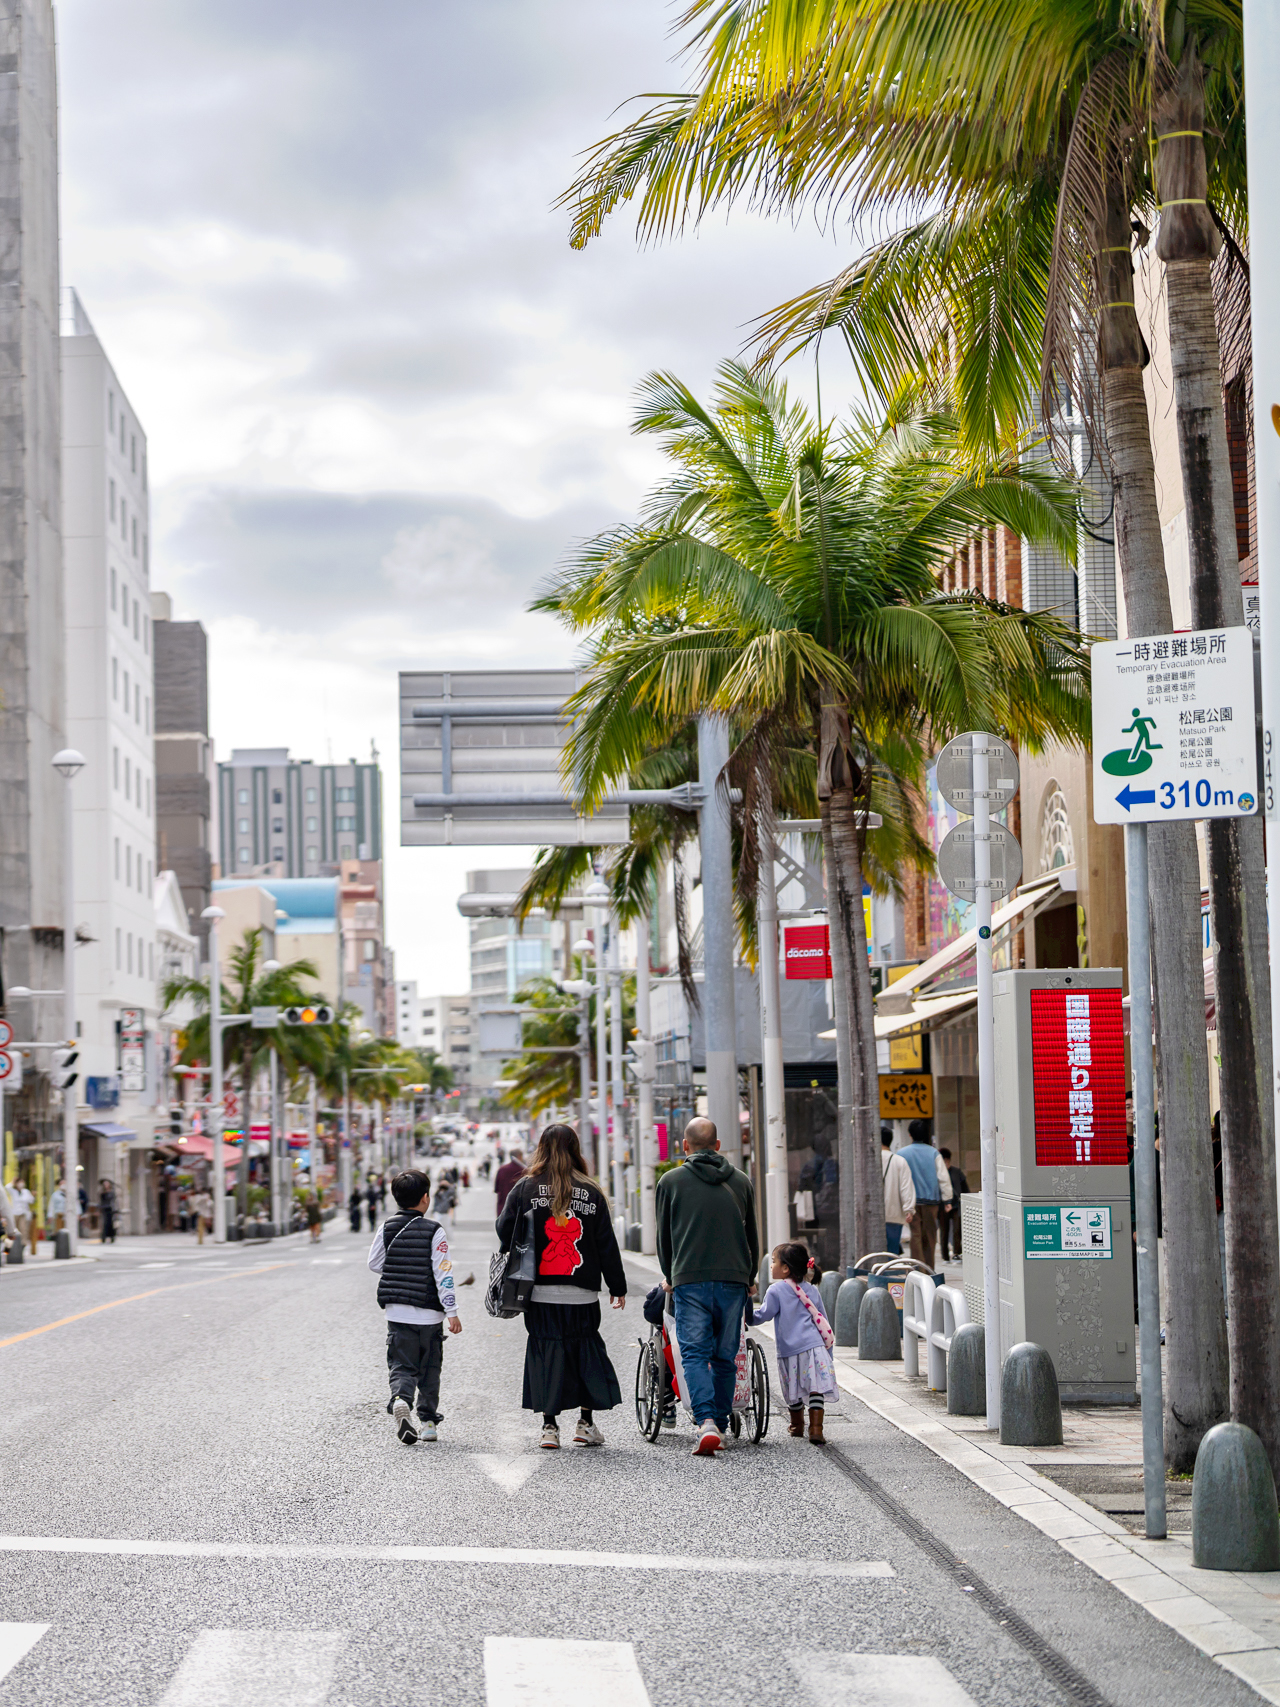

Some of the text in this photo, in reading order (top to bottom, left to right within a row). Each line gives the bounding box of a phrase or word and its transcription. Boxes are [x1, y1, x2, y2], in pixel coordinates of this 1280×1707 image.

[1116, 634, 1226, 661] 一時避難場所
[1116, 656, 1227, 674] Temporary Evacuation Area
[1147, 670, 1196, 683] 應急避難場所
[1147, 681, 1196, 695] 应急避难场所
[1147, 693, 1197, 706] 일시 피난 장소
[1179, 706, 1233, 725] 松尾公園
[1179, 725, 1226, 737] Matsuo Park
[1180, 736, 1213, 748] 松尾公園
[1180, 748, 1213, 760] 松尾公园
[1180, 758, 1220, 769] 마쓰오 공원
[1160, 779, 1233, 809] 310m
[787, 948, 824, 958] docomo
